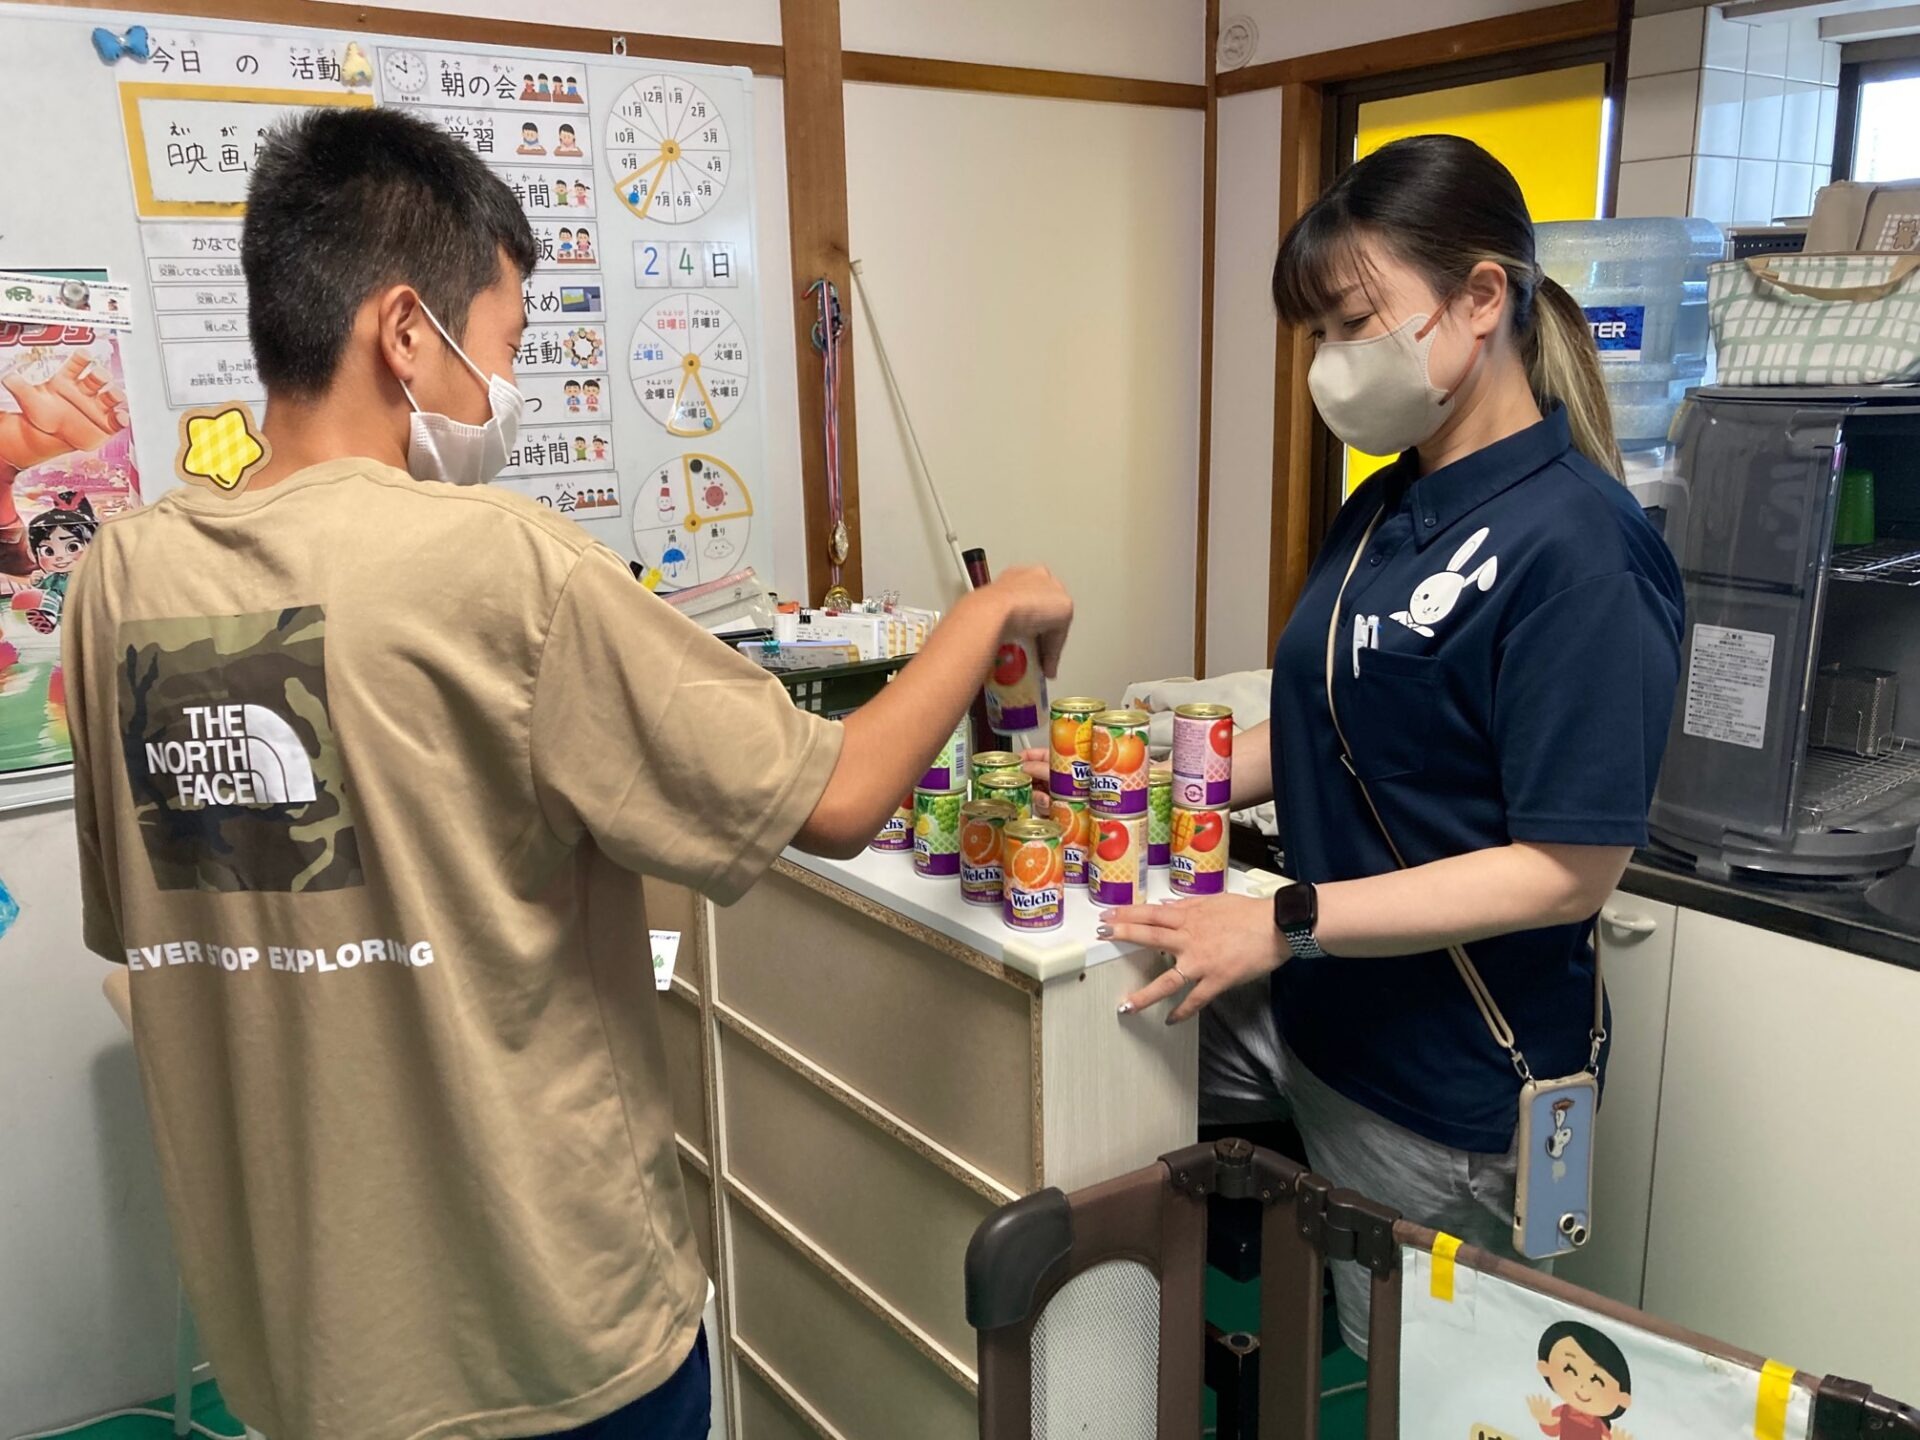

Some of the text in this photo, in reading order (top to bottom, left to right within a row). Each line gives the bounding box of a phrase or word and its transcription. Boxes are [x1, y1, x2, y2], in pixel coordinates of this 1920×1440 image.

[150, 46, 341, 82] 今日 の 活動
[441, 70, 517, 100] 朝の会
[643, 91, 663, 104] 12月
[669, 92, 683, 104] 1月
[622, 106, 642, 118] 11月
[691, 106, 706, 118] 2月
[615, 131, 635, 143] 10月
[703, 131, 718, 143] 3月
[621, 157, 637, 170] 9月
[707, 161, 722, 172] 4月
[697, 184, 712, 196] 5月
[655, 195, 670, 207] 7月
[676, 195, 691, 207] 6月
[644, 247, 730, 278] 2 4 日
[658, 319, 687, 330] 日曜日
[692, 317, 720, 328] 月曜日
[517, 341, 562, 364] 活動
[633, 350, 664, 361] 土曜日
[714, 350, 742, 361] 火曜日
[645, 388, 675, 399] 金曜日
[710, 387, 738, 398] 水曜日
[183, 704, 245, 738] THE
[145, 739, 248, 774] NORTH
[175, 772, 255, 806] FACE
[962, 867, 1001, 881] Welch's
[1012, 891, 1056, 908] Welch's
[207, 943, 260, 971] STOP
[267, 938, 434, 973] EXPLORING
